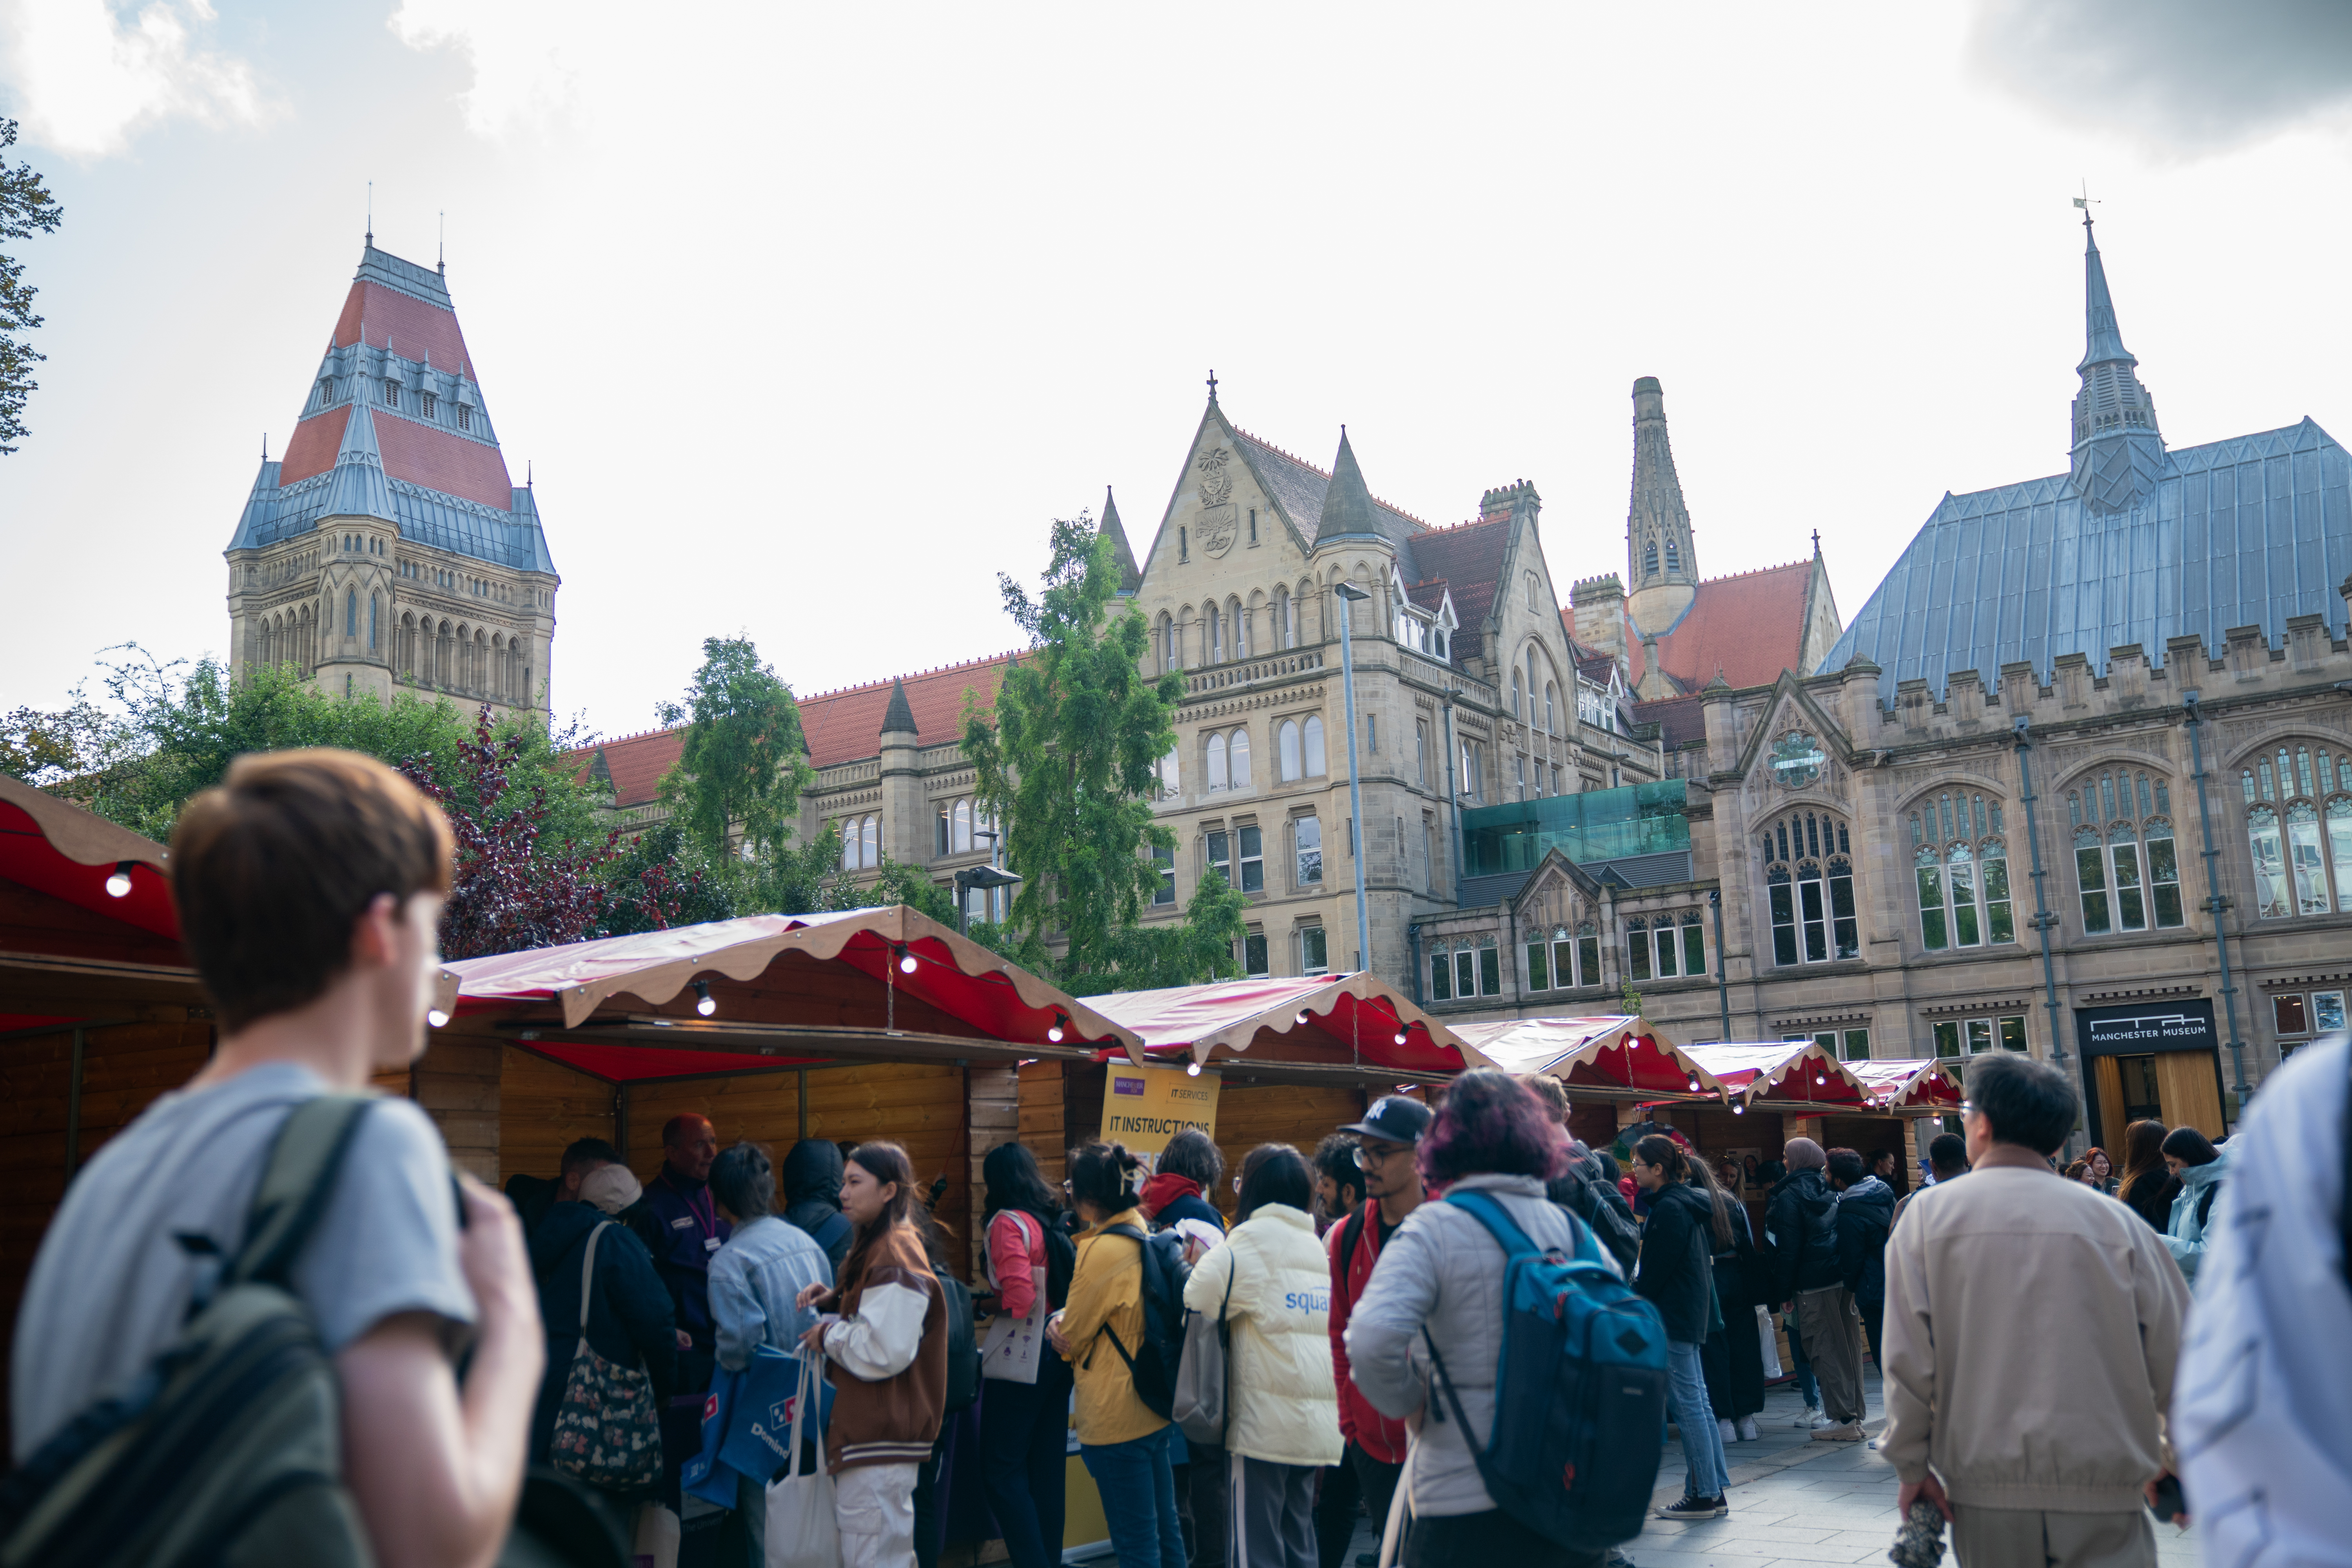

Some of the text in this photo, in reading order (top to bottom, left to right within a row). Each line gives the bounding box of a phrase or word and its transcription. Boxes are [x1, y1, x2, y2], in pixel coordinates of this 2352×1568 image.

[2092, 1026, 2206, 1041] MANCHESTER MUSEUM
[1171, 1089, 1208, 1101] IT SERVICES
[1109, 1116, 1121, 1131] IT
[1285, 1292, 1330, 1316] squa
